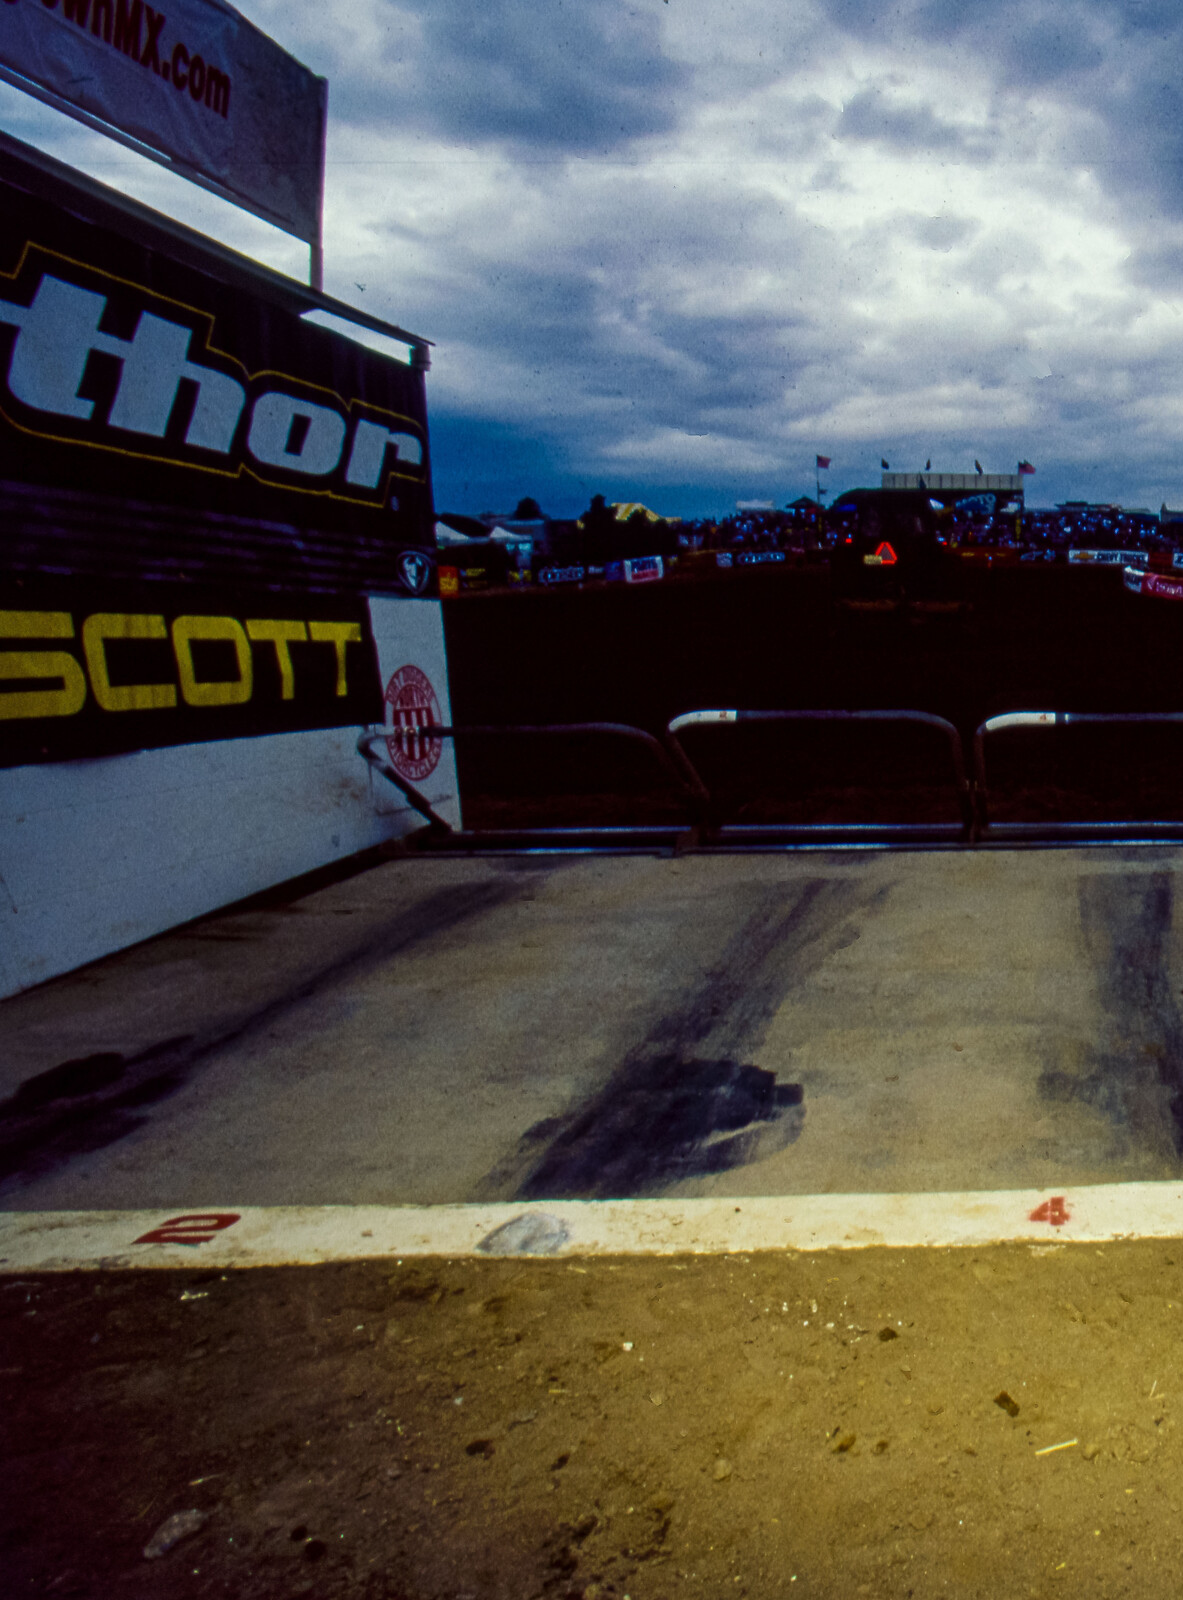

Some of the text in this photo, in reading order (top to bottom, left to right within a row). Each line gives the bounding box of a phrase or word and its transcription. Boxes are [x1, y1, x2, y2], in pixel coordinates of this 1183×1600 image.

[0, 273, 423, 489] thor
[0, 609, 362, 720] SCOTT
[131, 1213, 241, 1246] 2
[1029, 1196, 1070, 1226] 4
